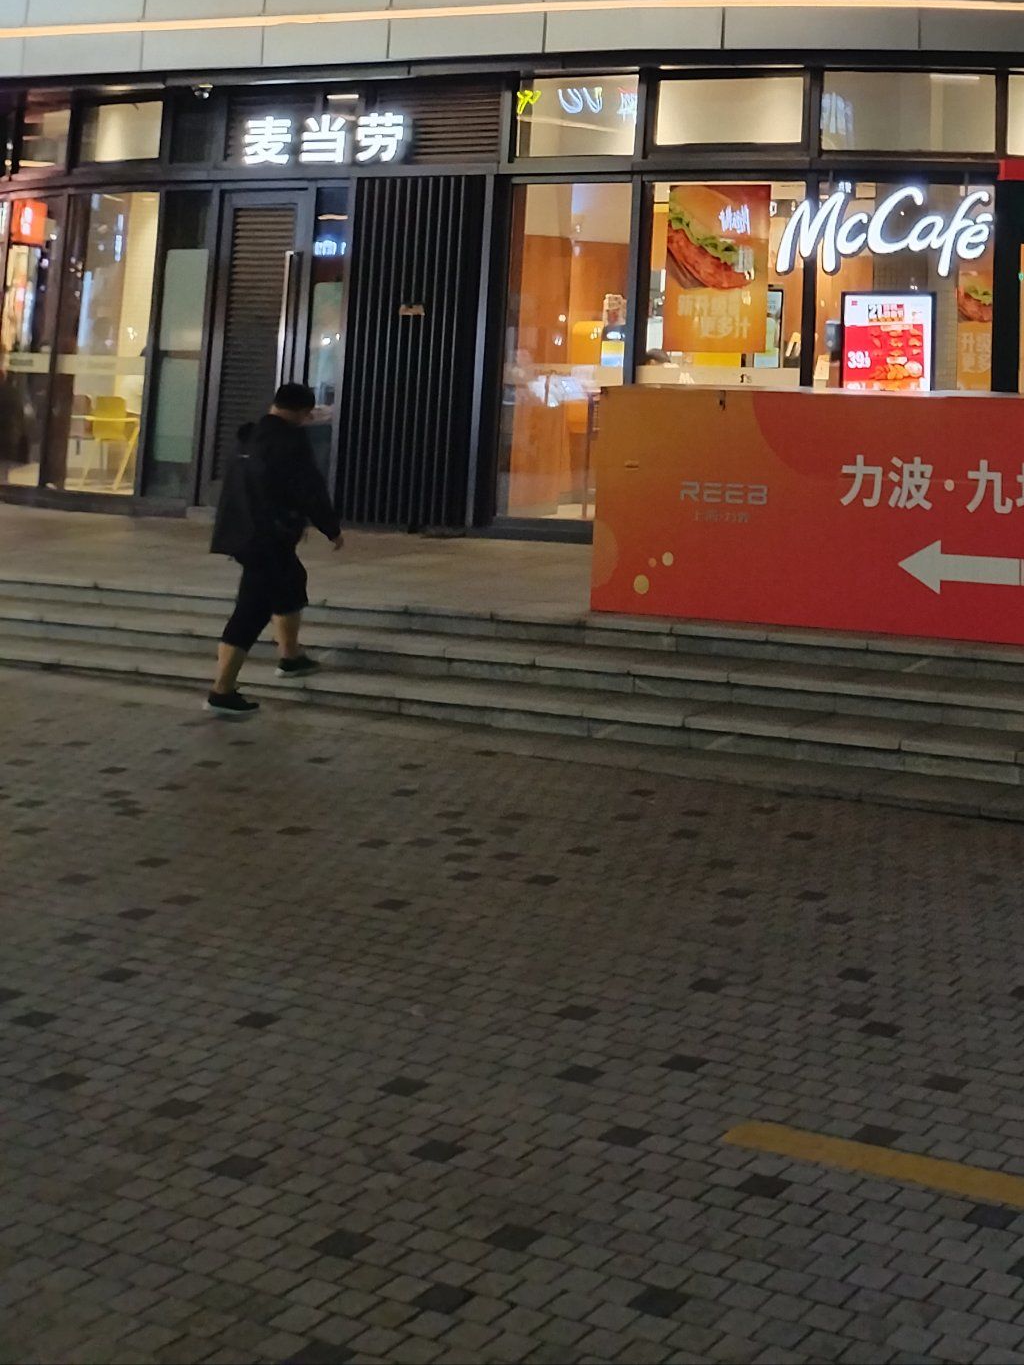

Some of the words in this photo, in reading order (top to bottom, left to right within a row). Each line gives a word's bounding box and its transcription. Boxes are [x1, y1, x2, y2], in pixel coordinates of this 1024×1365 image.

[242, 112, 404, 166] 麦当劳
[775, 185, 994, 278] McCafé
[679, 480, 769, 506] REEB
